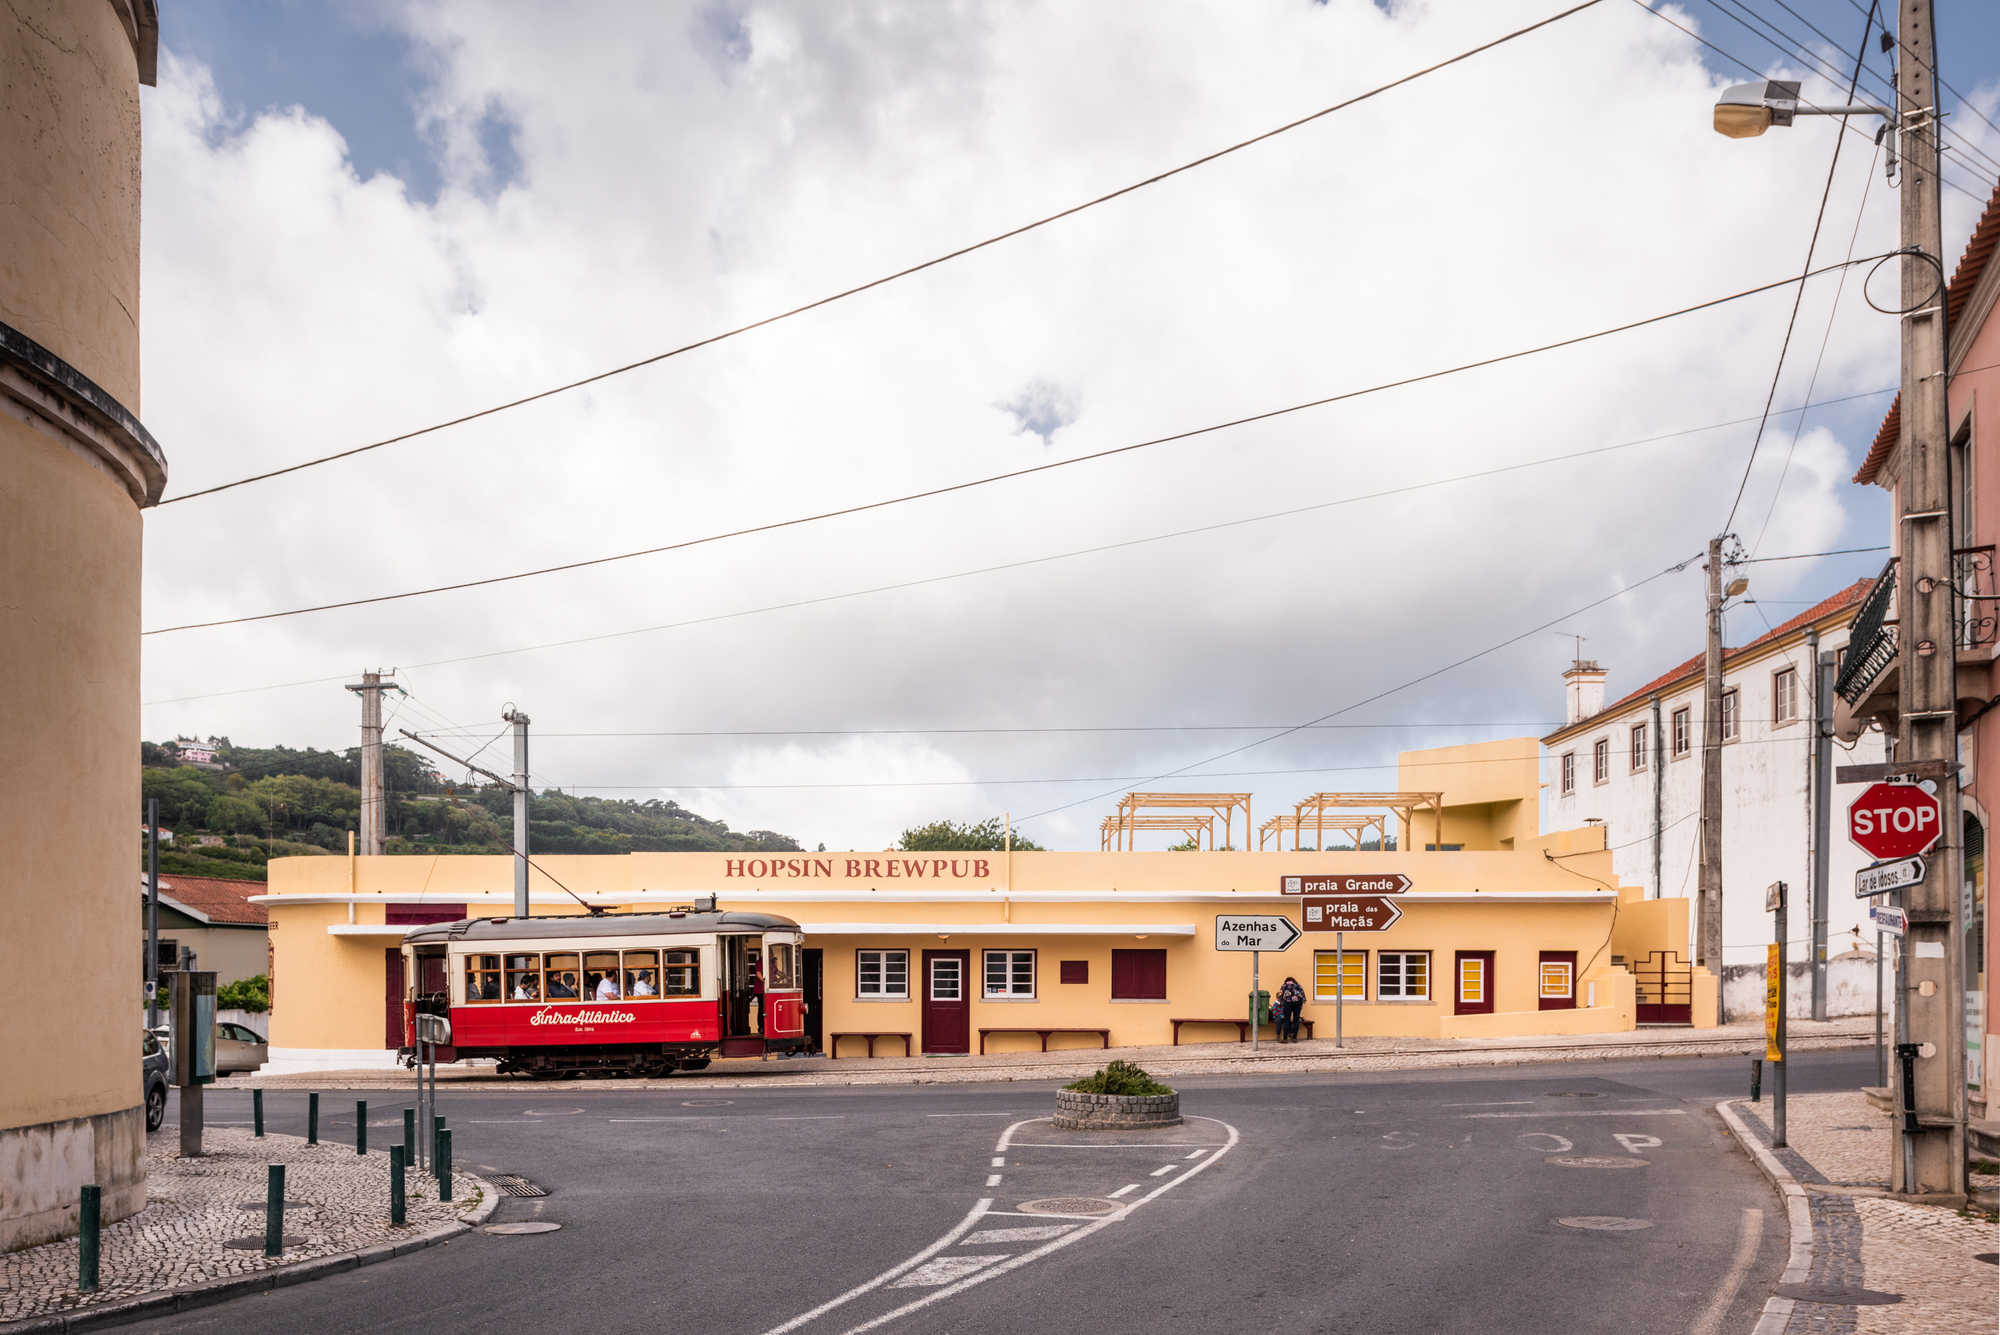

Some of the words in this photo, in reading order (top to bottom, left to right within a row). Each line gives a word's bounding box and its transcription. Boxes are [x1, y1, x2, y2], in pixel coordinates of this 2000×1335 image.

[1854, 806, 1935, 835] STOP
[725, 859, 833, 878] HOPSIN
[845, 859, 990, 878] BREWPUB
[1305, 880, 1338, 893] praia
[1345, 879, 1393, 890] Grande
[1869, 873, 1877, 890] de
[1878, 869, 1899, 888] idosos
[1326, 901, 1359, 915] praia
[1365, 905, 1378, 913] das
[1222, 921, 1277, 932] Azenhas
[1331, 916, 1374, 930] Maçãs
[1237, 935, 1262, 946] Mar
